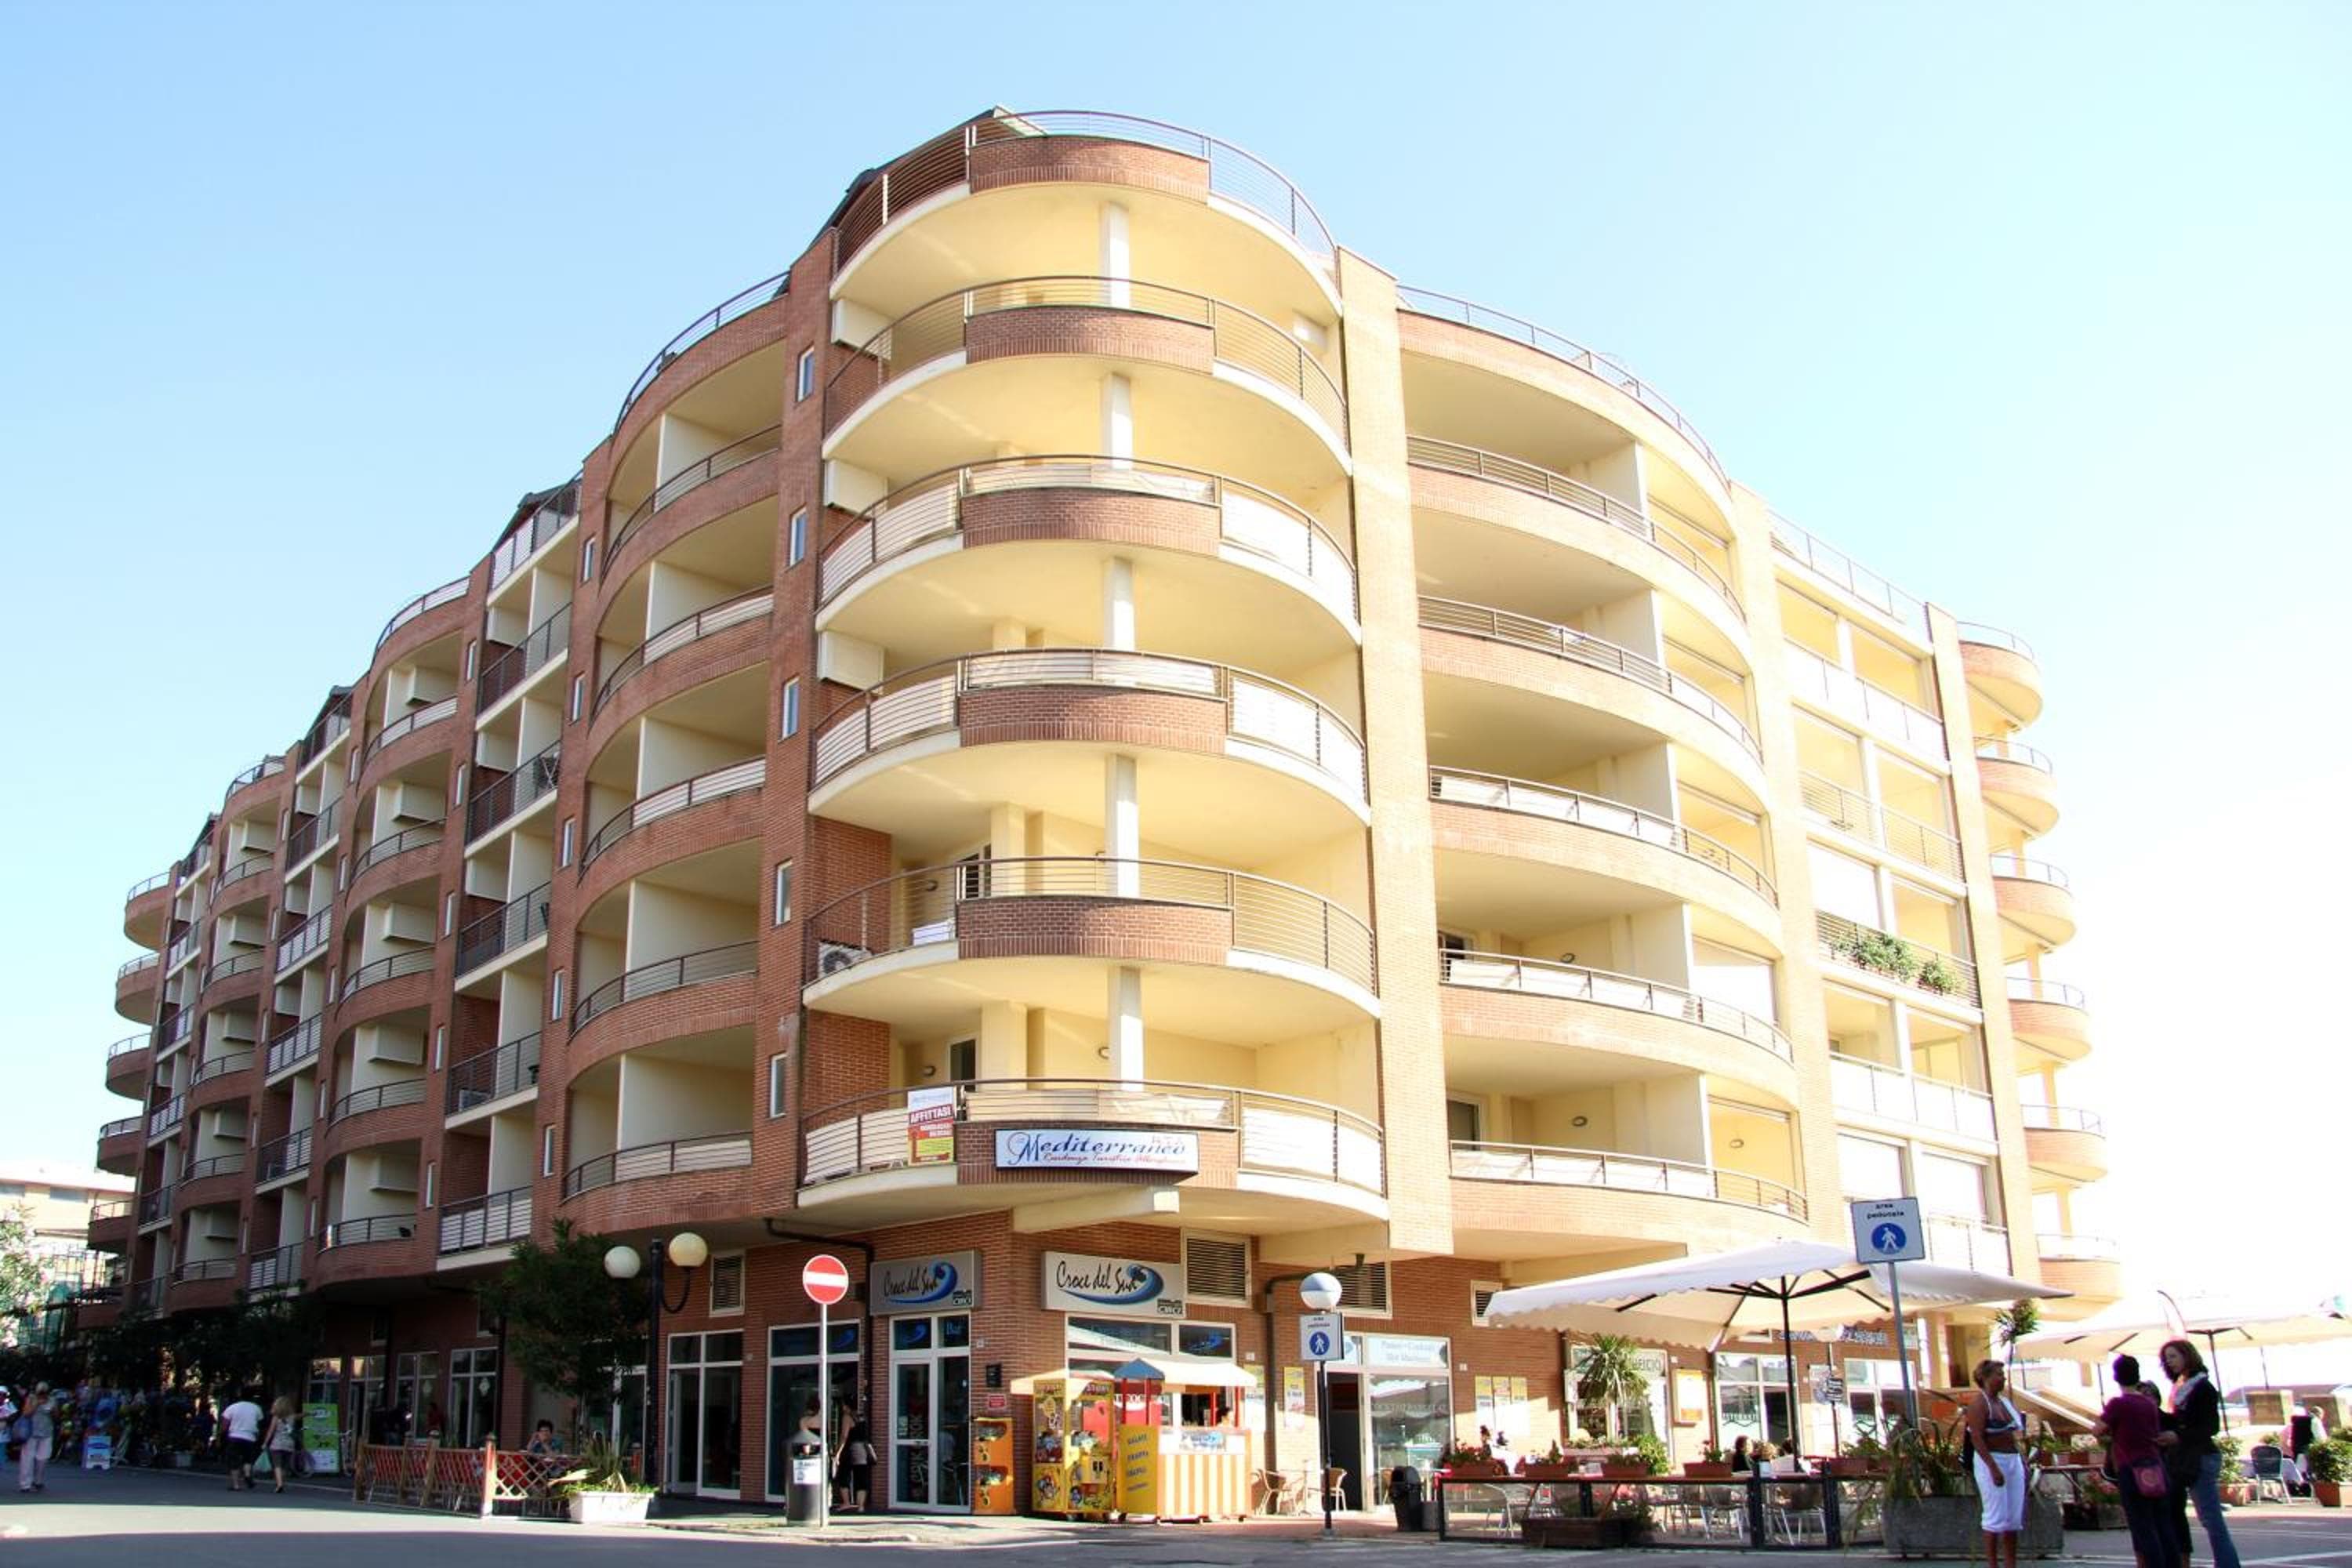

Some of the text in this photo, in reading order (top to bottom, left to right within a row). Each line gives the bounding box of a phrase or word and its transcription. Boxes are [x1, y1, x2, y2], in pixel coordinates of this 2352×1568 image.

[910, 1105, 952, 1123] AFFITTASI
[1007, 1131, 1185, 1165] Mediterraneo
[884, 1270, 906, 1297] Croce
[906, 1267, 920, 1292] del
[1056, 1261, 1091, 1288] Croce
[1092, 1263, 1111, 1290] del
